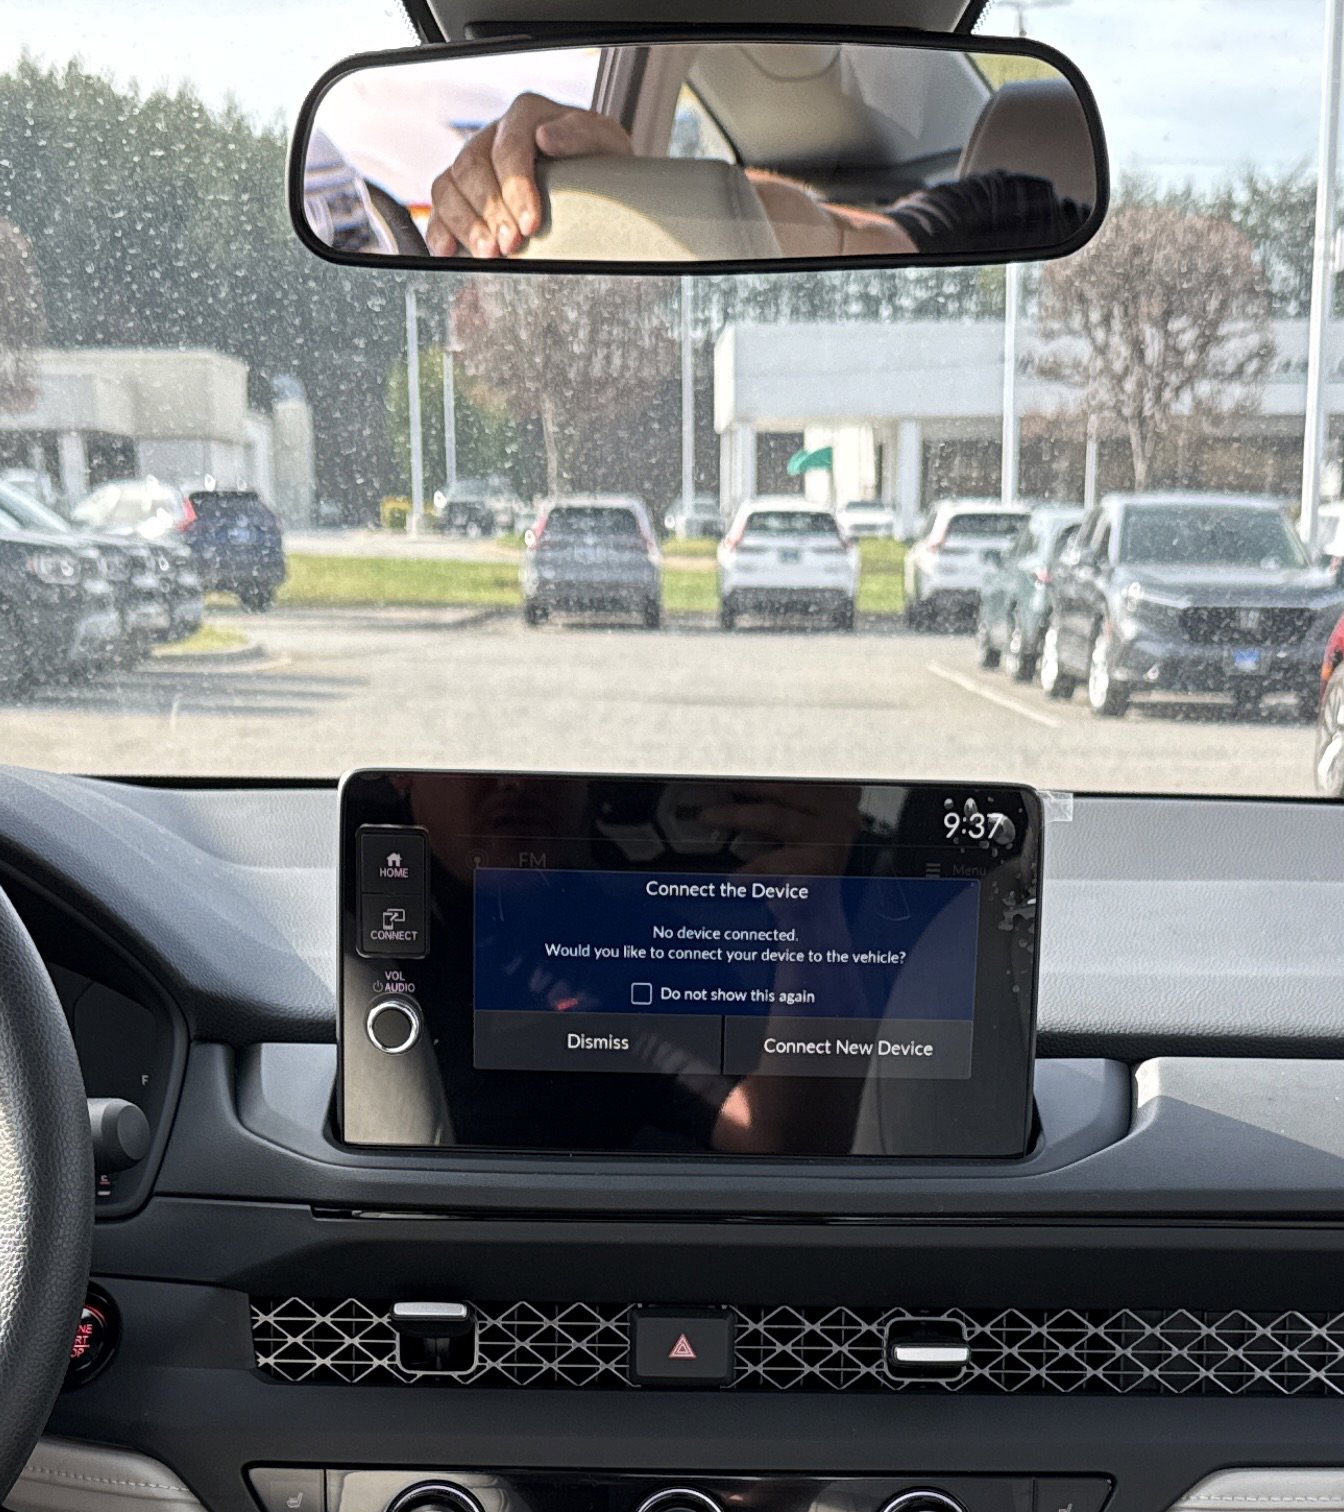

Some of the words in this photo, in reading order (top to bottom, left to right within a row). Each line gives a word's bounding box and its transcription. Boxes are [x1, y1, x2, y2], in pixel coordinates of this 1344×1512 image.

[943, 812, 1005, 839] 9:37
[519, 852, 547, 868] FM
[379, 867, 409, 879] HOME
[952, 865, 987, 876] Menu
[645, 880, 716, 898] Connect
[719, 882, 747, 898] the
[751, 882, 809, 899] Device
[370, 930, 419, 941] CONNECT
[652, 926, 674, 940] No
[676, 926, 722, 941] device
[723, 928, 799, 942] connected.
[544, 943, 591, 958] Would
[594, 946, 620, 961] you
[623, 944, 647, 959] like
[650, 946, 665, 960] to
[667, 947, 723, 961] connect
[725, 949, 758, 963] your
[760, 948, 805, 962] device
[808, 949, 823, 963] to
[826, 949, 849, 963] the
[852, 950, 907, 964] vehicle?
[384, 970, 406, 981] VOL
[384, 982, 416, 993] AUDIO
[660, 987, 681, 1001] Do
[684, 988, 708, 1001] not
[710, 988, 747, 1002] show
[750, 988, 775, 1003] this
[779, 989, 816, 1005] again
[567, 1033, 630, 1050] Dismiss
[763, 1037, 832, 1055] Connect
[835, 1039, 873, 1055] New
[877, 1040, 934, 1056] Device
